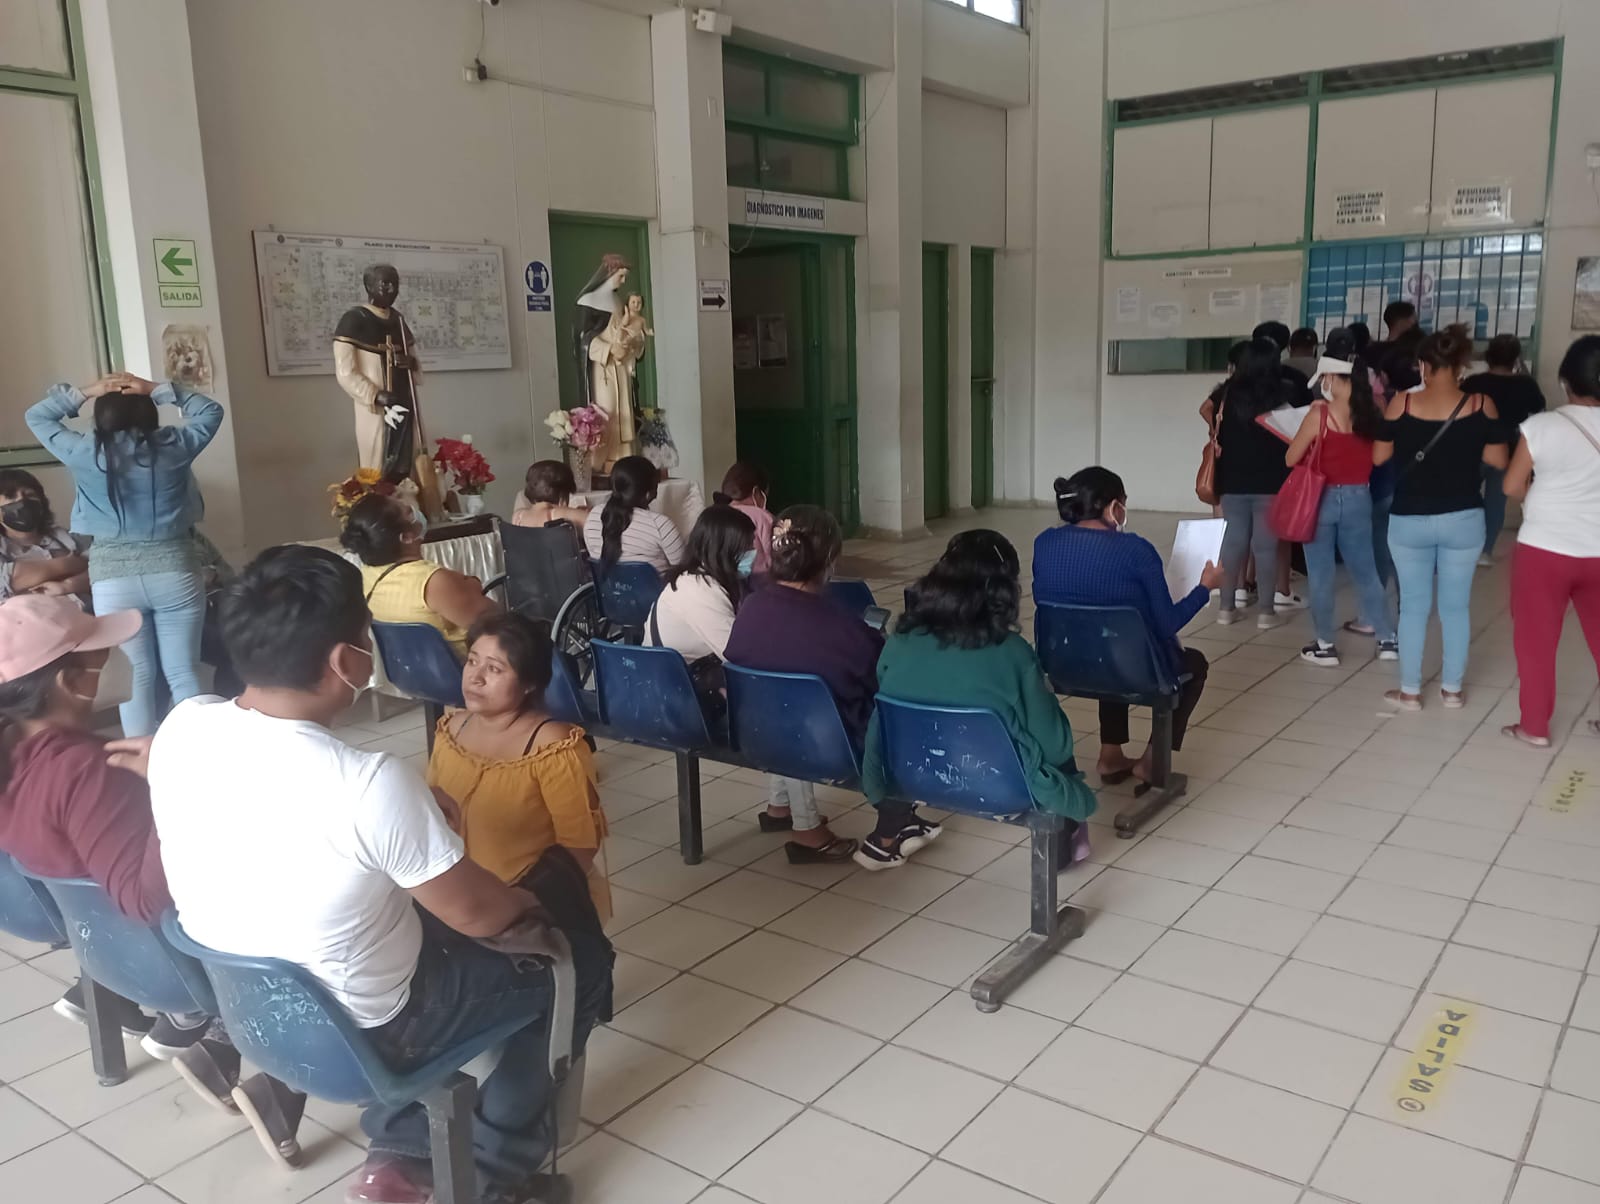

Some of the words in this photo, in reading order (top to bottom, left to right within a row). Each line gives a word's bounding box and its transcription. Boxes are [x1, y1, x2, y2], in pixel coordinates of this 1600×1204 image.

[746, 201, 784, 217] DIAGNOSTICO
[785, 206, 796, 218] POR
[797, 206, 824, 221] IMAGENES
[162, 291, 199, 301] SALIDA
[1408, 1009, 1468, 1093] SALIDA
